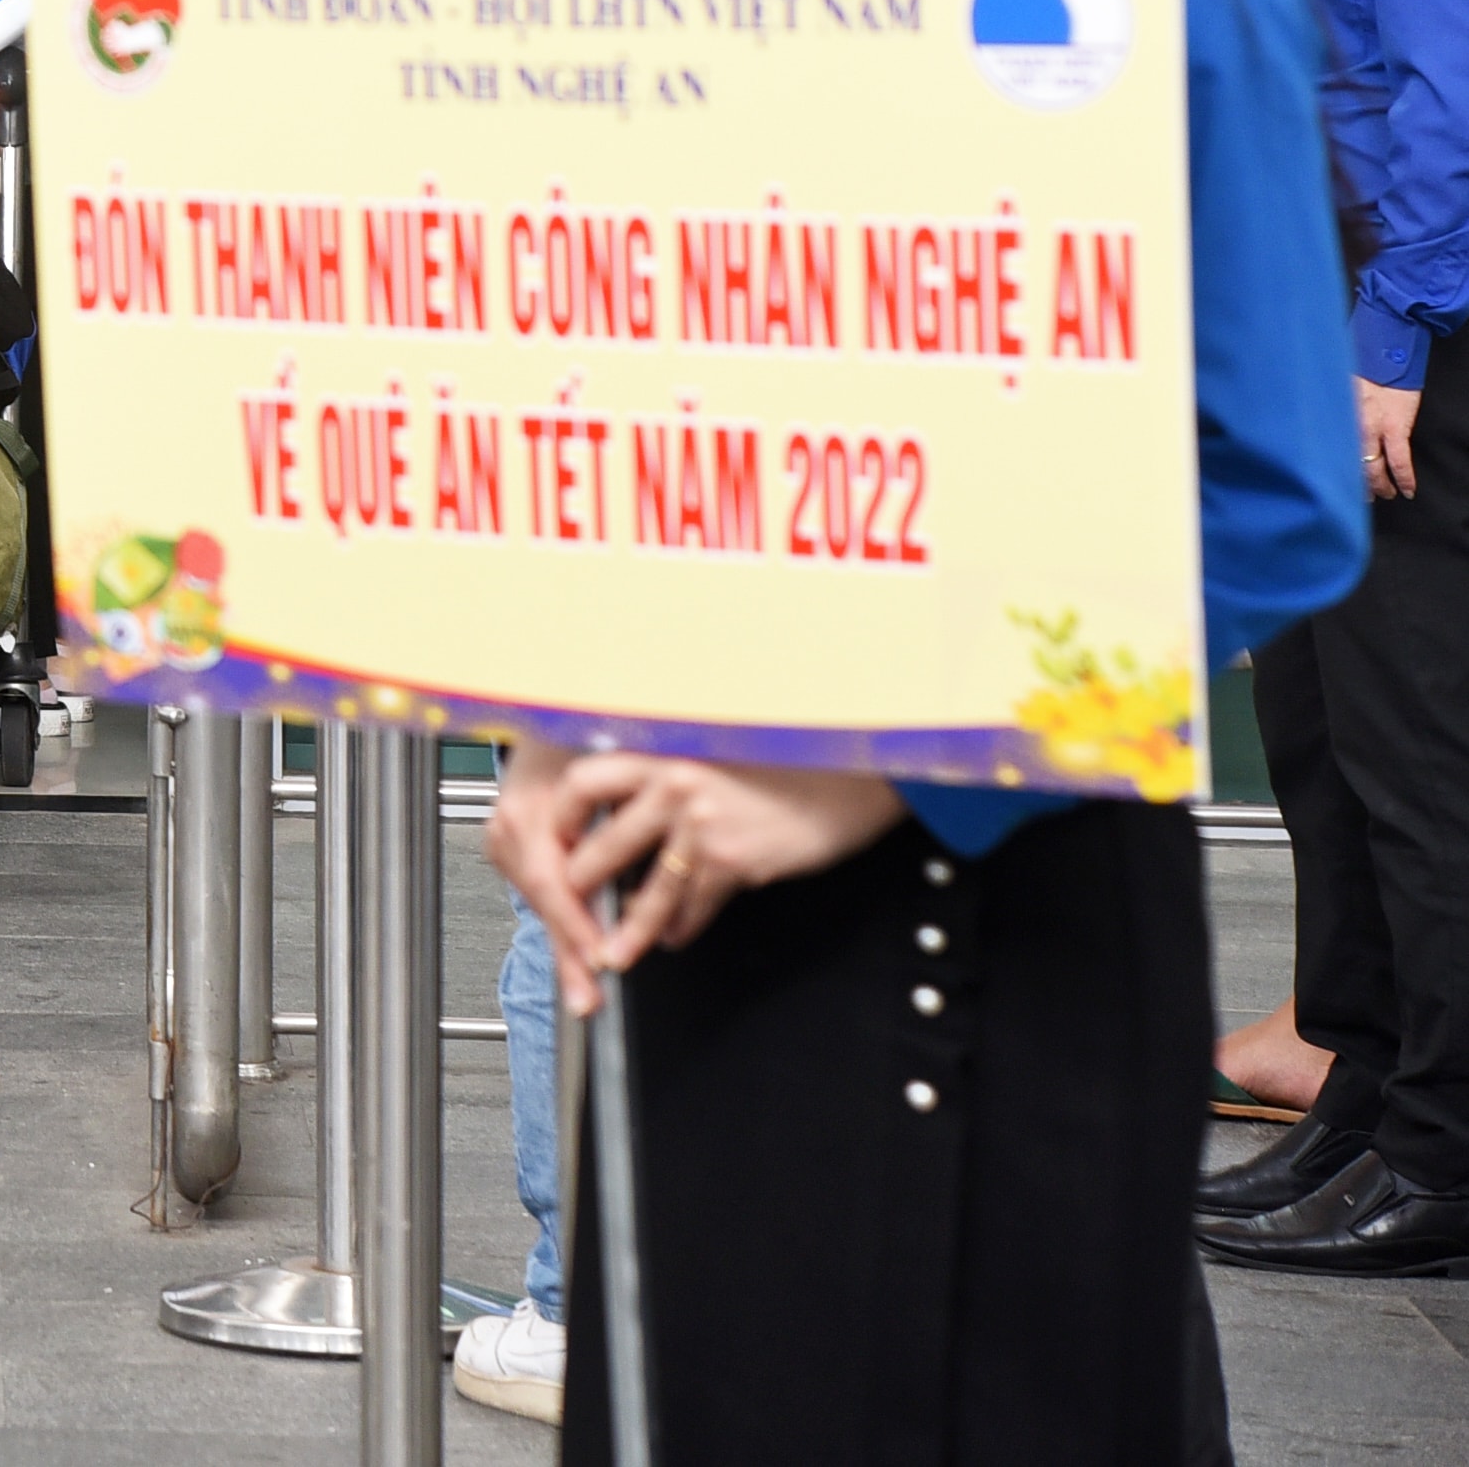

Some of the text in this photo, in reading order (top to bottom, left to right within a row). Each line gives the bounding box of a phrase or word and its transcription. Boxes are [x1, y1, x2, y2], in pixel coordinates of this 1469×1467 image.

[658, 68, 707, 105] AN
[180, 198, 347, 326] THANH
[363, 181, 488, 334] NIÊN
[507, 185, 659, 341] CÔNG
[676, 192, 839, 350] NHÂN
[861, 198, 1028, 390] NGHỆ
[1047, 230, 1138, 363] AN
[317, 380, 415, 537] QUÊ
[432, 383, 505, 536] ĂN
[518, 370, 612, 544] TẾT
[630, 391, 765, 554] NĂM
[783, 430, 931, 567] 2022
